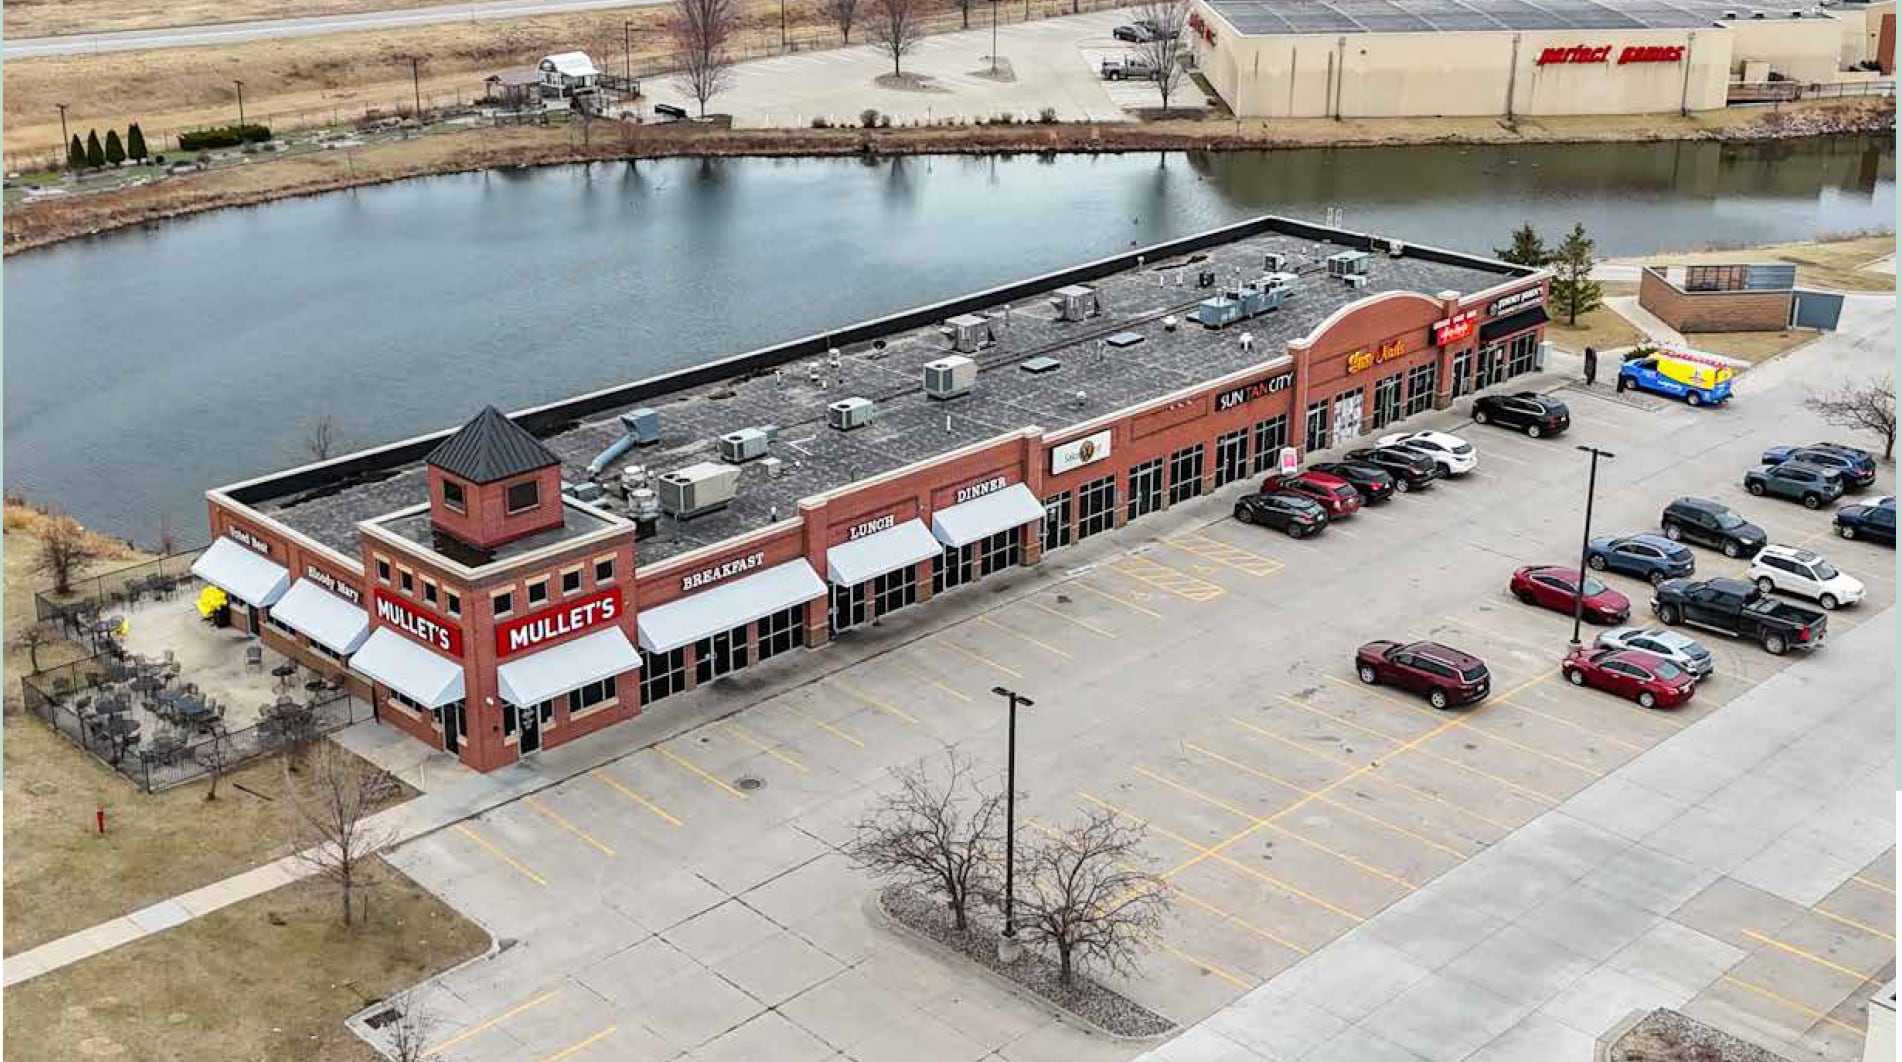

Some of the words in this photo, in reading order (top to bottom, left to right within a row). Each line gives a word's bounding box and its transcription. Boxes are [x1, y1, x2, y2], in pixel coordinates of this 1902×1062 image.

[1537, 44, 1612, 65] perfect
[1220, 389, 1244, 411] SUN
[1246, 382, 1268, 400] TAN
[1268, 371, 1295, 393] CITY
[957, 476, 1008, 503] DINNER
[849, 514, 895, 539] LUNCH
[307, 565, 335, 591] Bloody
[336, 580, 361, 603] Mary
[682, 552, 765, 591] BREAKFAST
[376, 597, 451, 650] MULLET'S
[509, 597, 616, 650] MULLET'S
